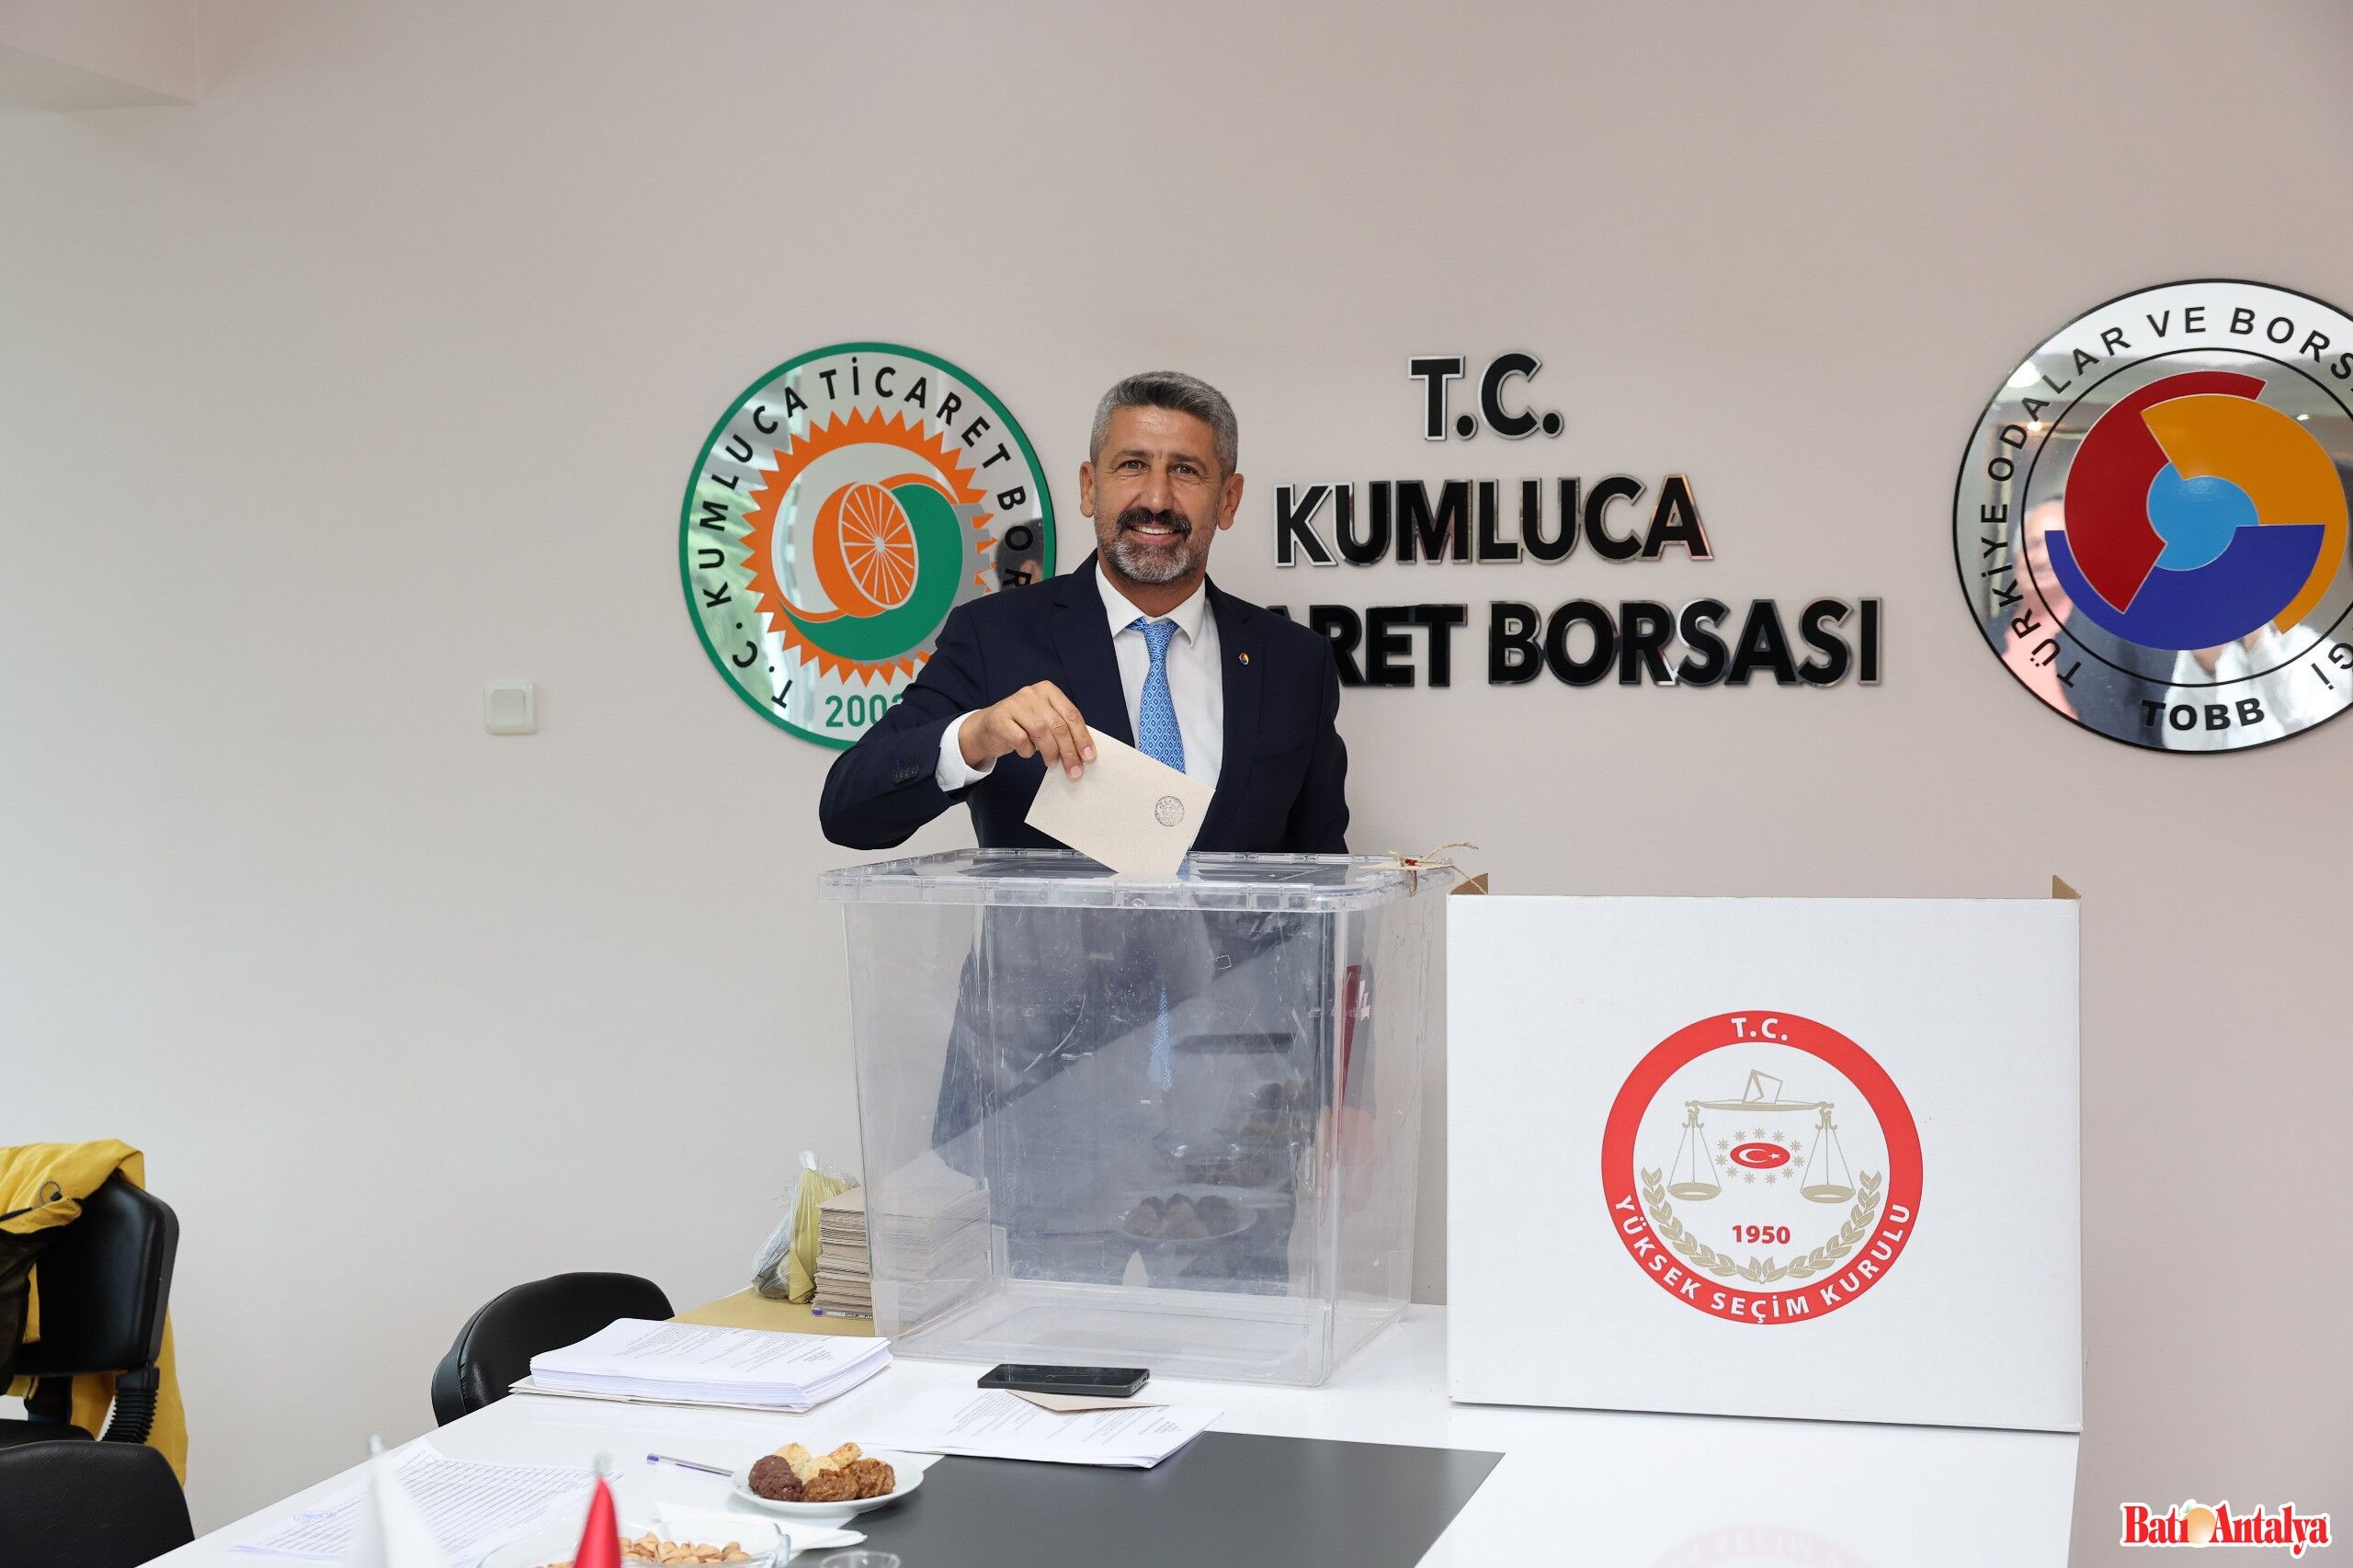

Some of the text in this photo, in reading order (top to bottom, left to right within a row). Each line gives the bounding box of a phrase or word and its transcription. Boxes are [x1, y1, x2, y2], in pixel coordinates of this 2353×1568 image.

[2146, 306, 2207, 337] VE
[2230, 307, 2353, 394] BORS
[819, 356, 1011, 469] TİCARET
[1407, 350, 1563, 442] T.C.
[1987, 327, 2131, 482] ODALAR
[698, 386, 808, 608] KUMLUCA
[1273, 472, 1714, 566] KUMLUCA
[1267, 596, 1882, 688] RET BORSASI
[1981, 504, 2082, 688] TÜRKİYE
[732, 621, 792, 709] T.C.
[2141, 698, 2265, 732] TOBB
[1731, 1017, 1789, 1040] T.C.
[1614, 1194, 1911, 1324] YÜKSEK SEÇİM KURULU
[1732, 1224, 1791, 1244] 1950
